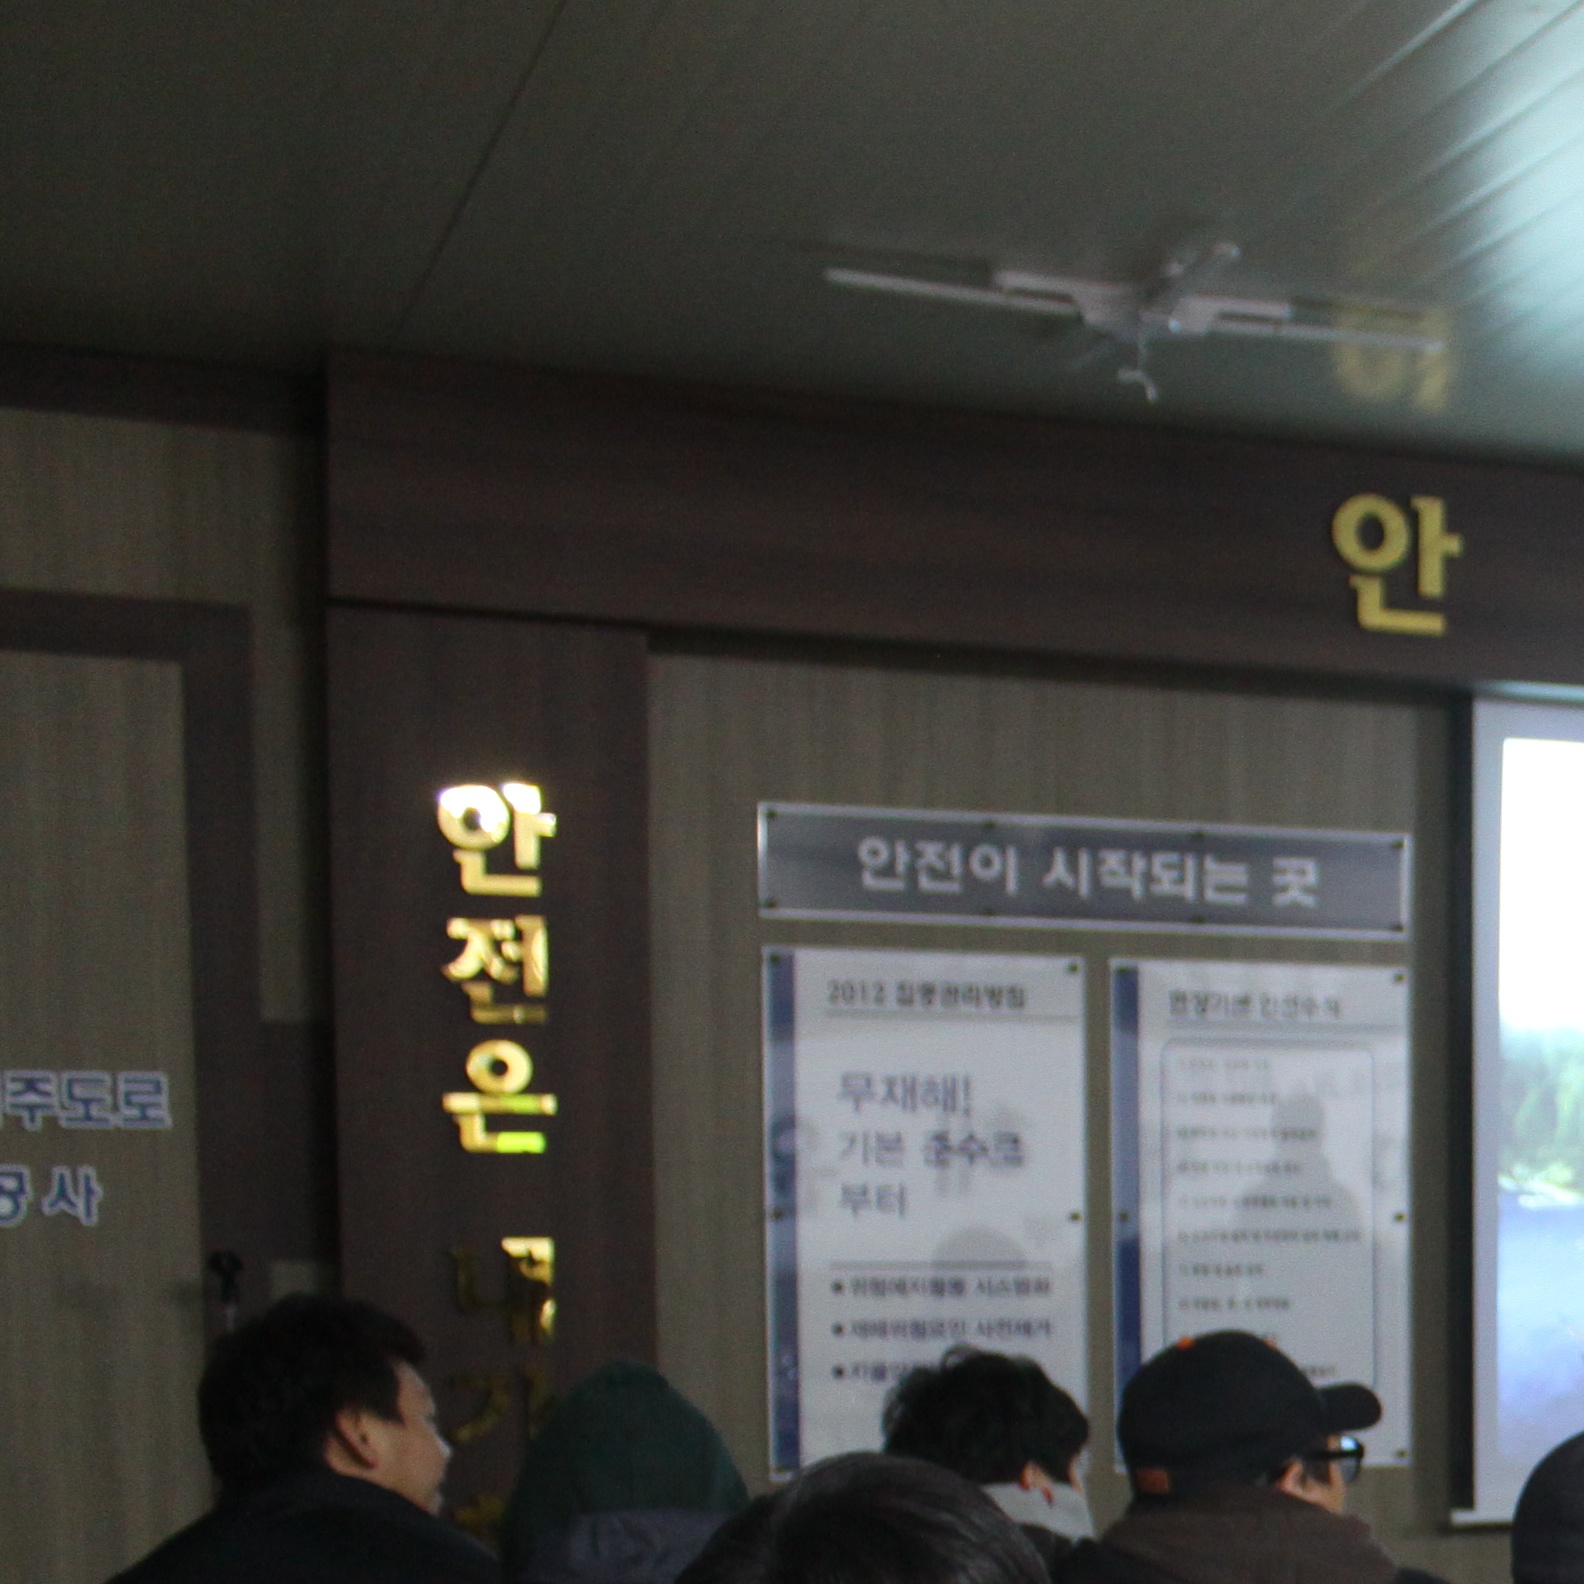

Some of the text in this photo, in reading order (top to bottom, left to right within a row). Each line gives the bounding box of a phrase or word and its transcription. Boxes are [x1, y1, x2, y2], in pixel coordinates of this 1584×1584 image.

[857, 836, 1319, 908] 안전이 시작되는 곳
[437, 782, 557, 1154] 안전은
[0, 1070, 173, 1131] 주도로
